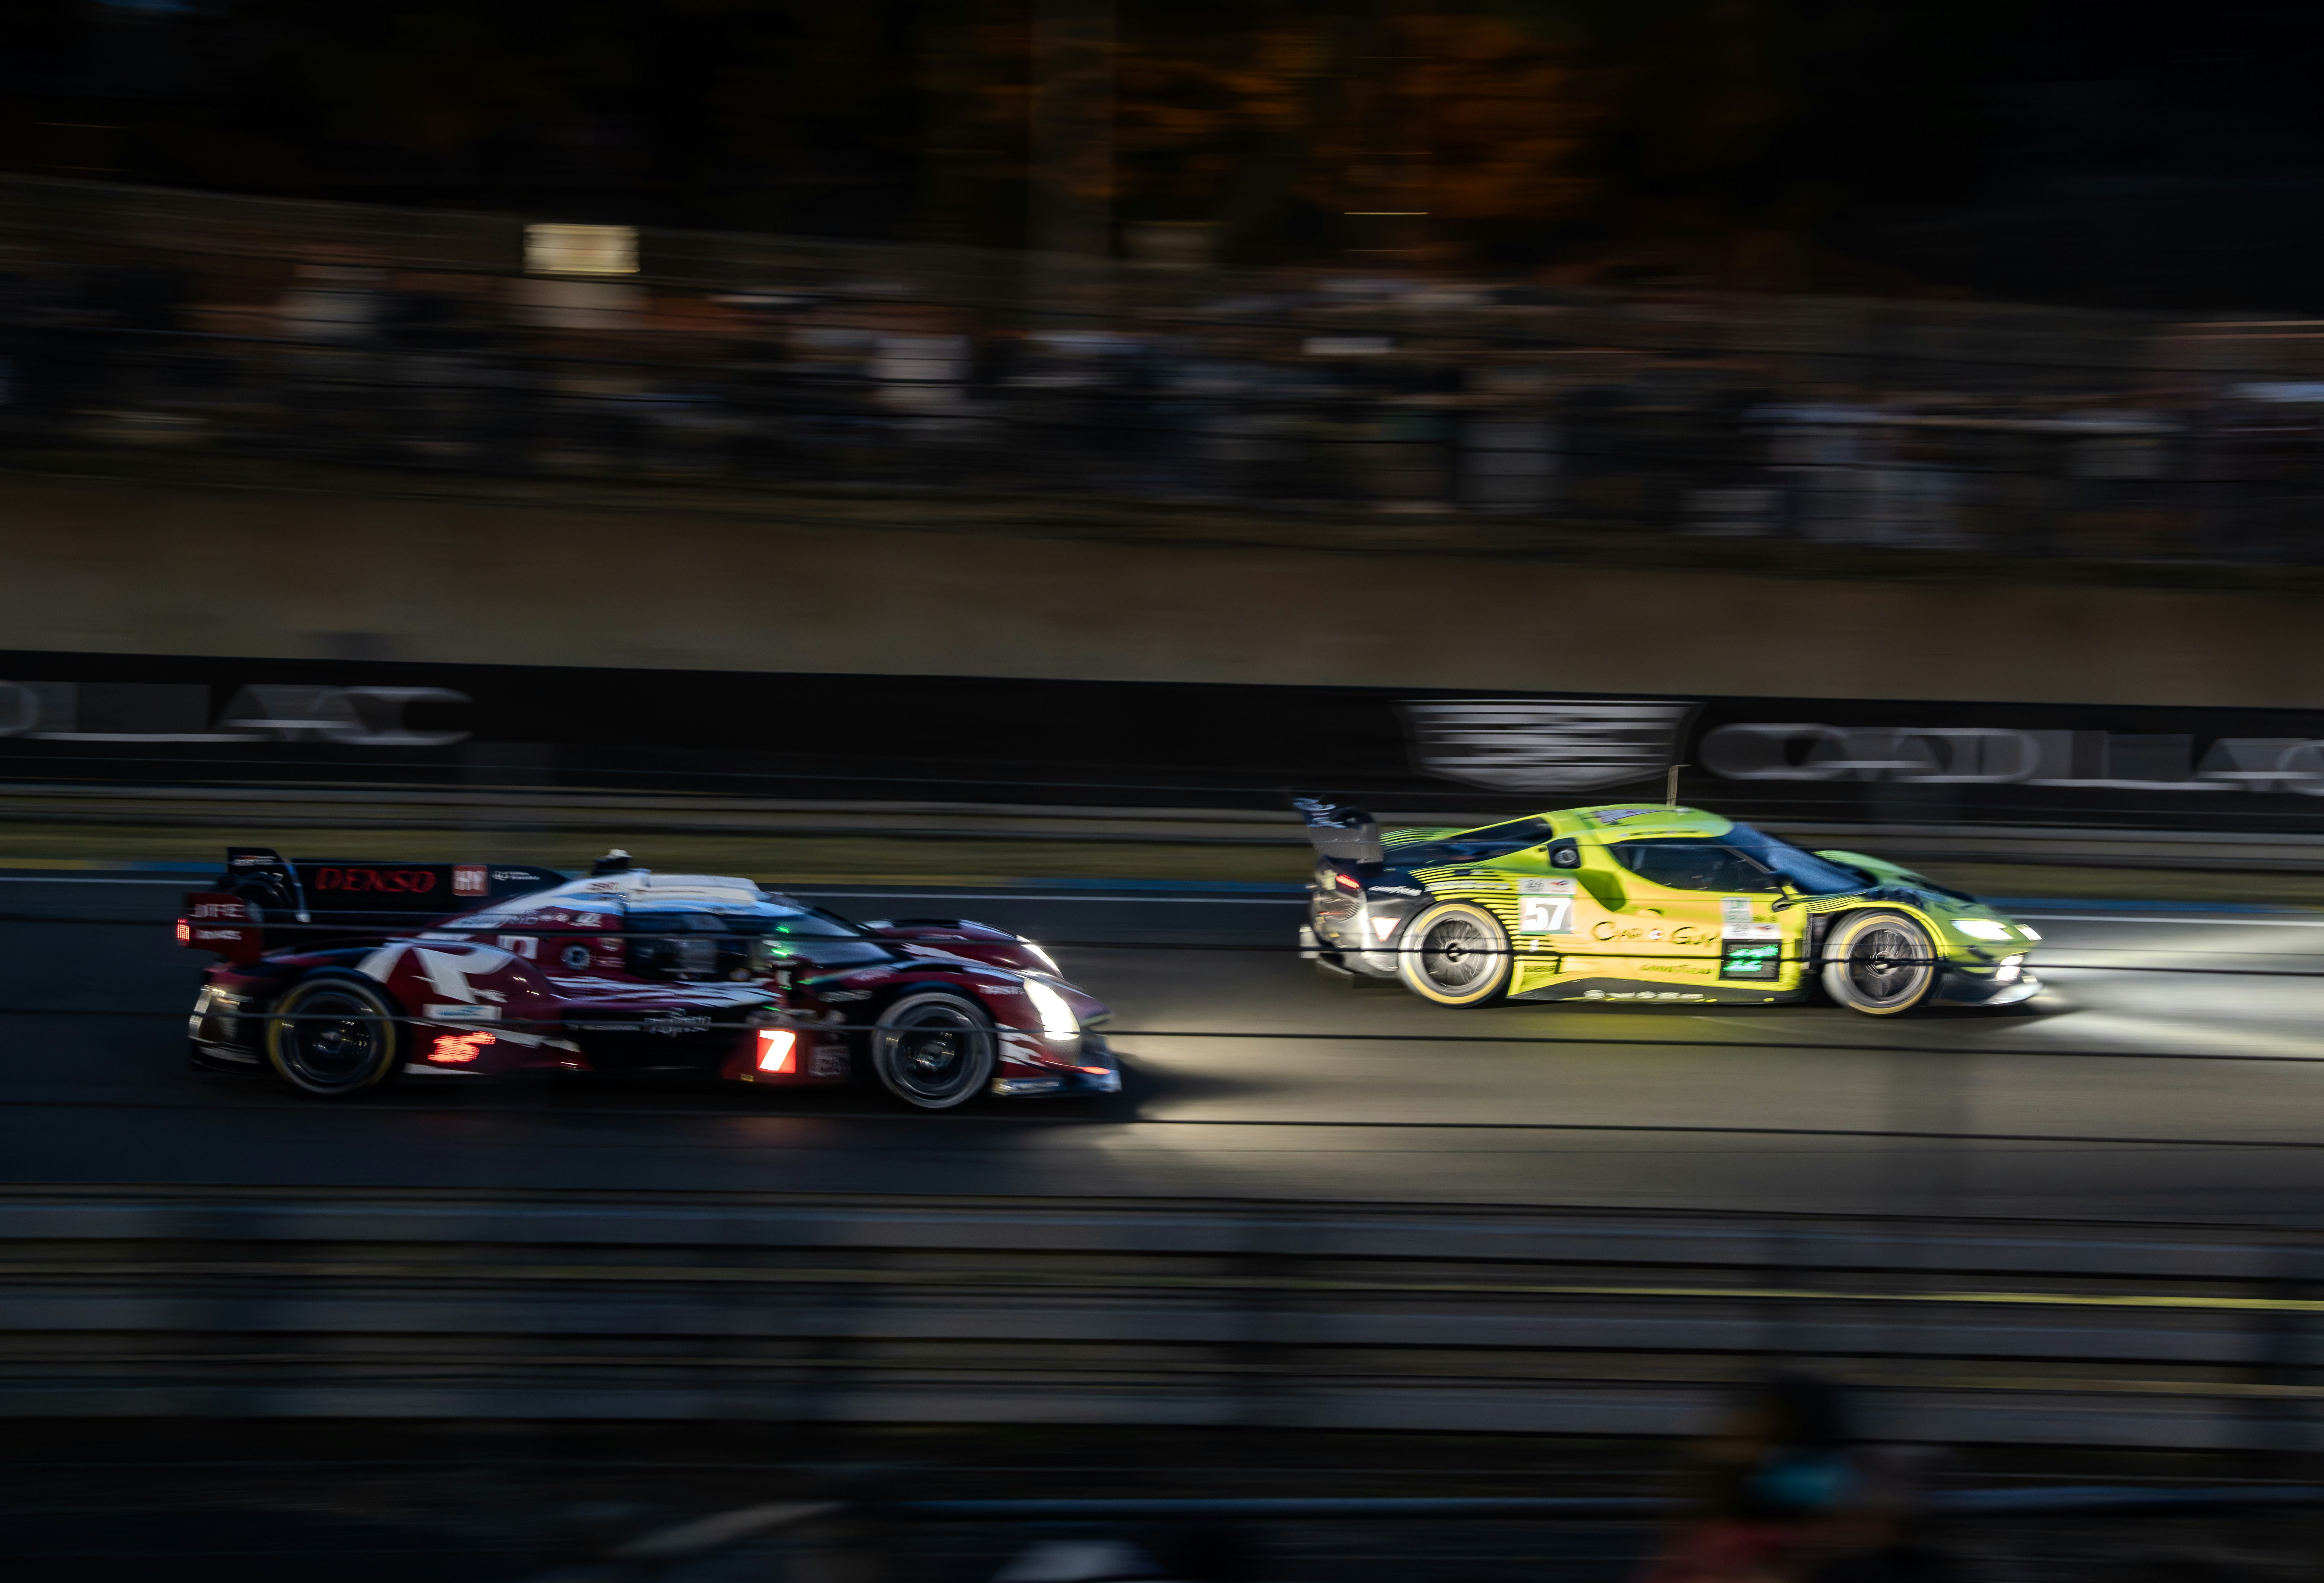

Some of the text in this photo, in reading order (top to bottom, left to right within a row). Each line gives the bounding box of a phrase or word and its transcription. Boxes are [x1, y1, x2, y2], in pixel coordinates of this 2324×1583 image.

[314, 867, 437, 893] DENSO
[1524, 897, 1571, 931] 57
[759, 1029, 796, 1071] 7
